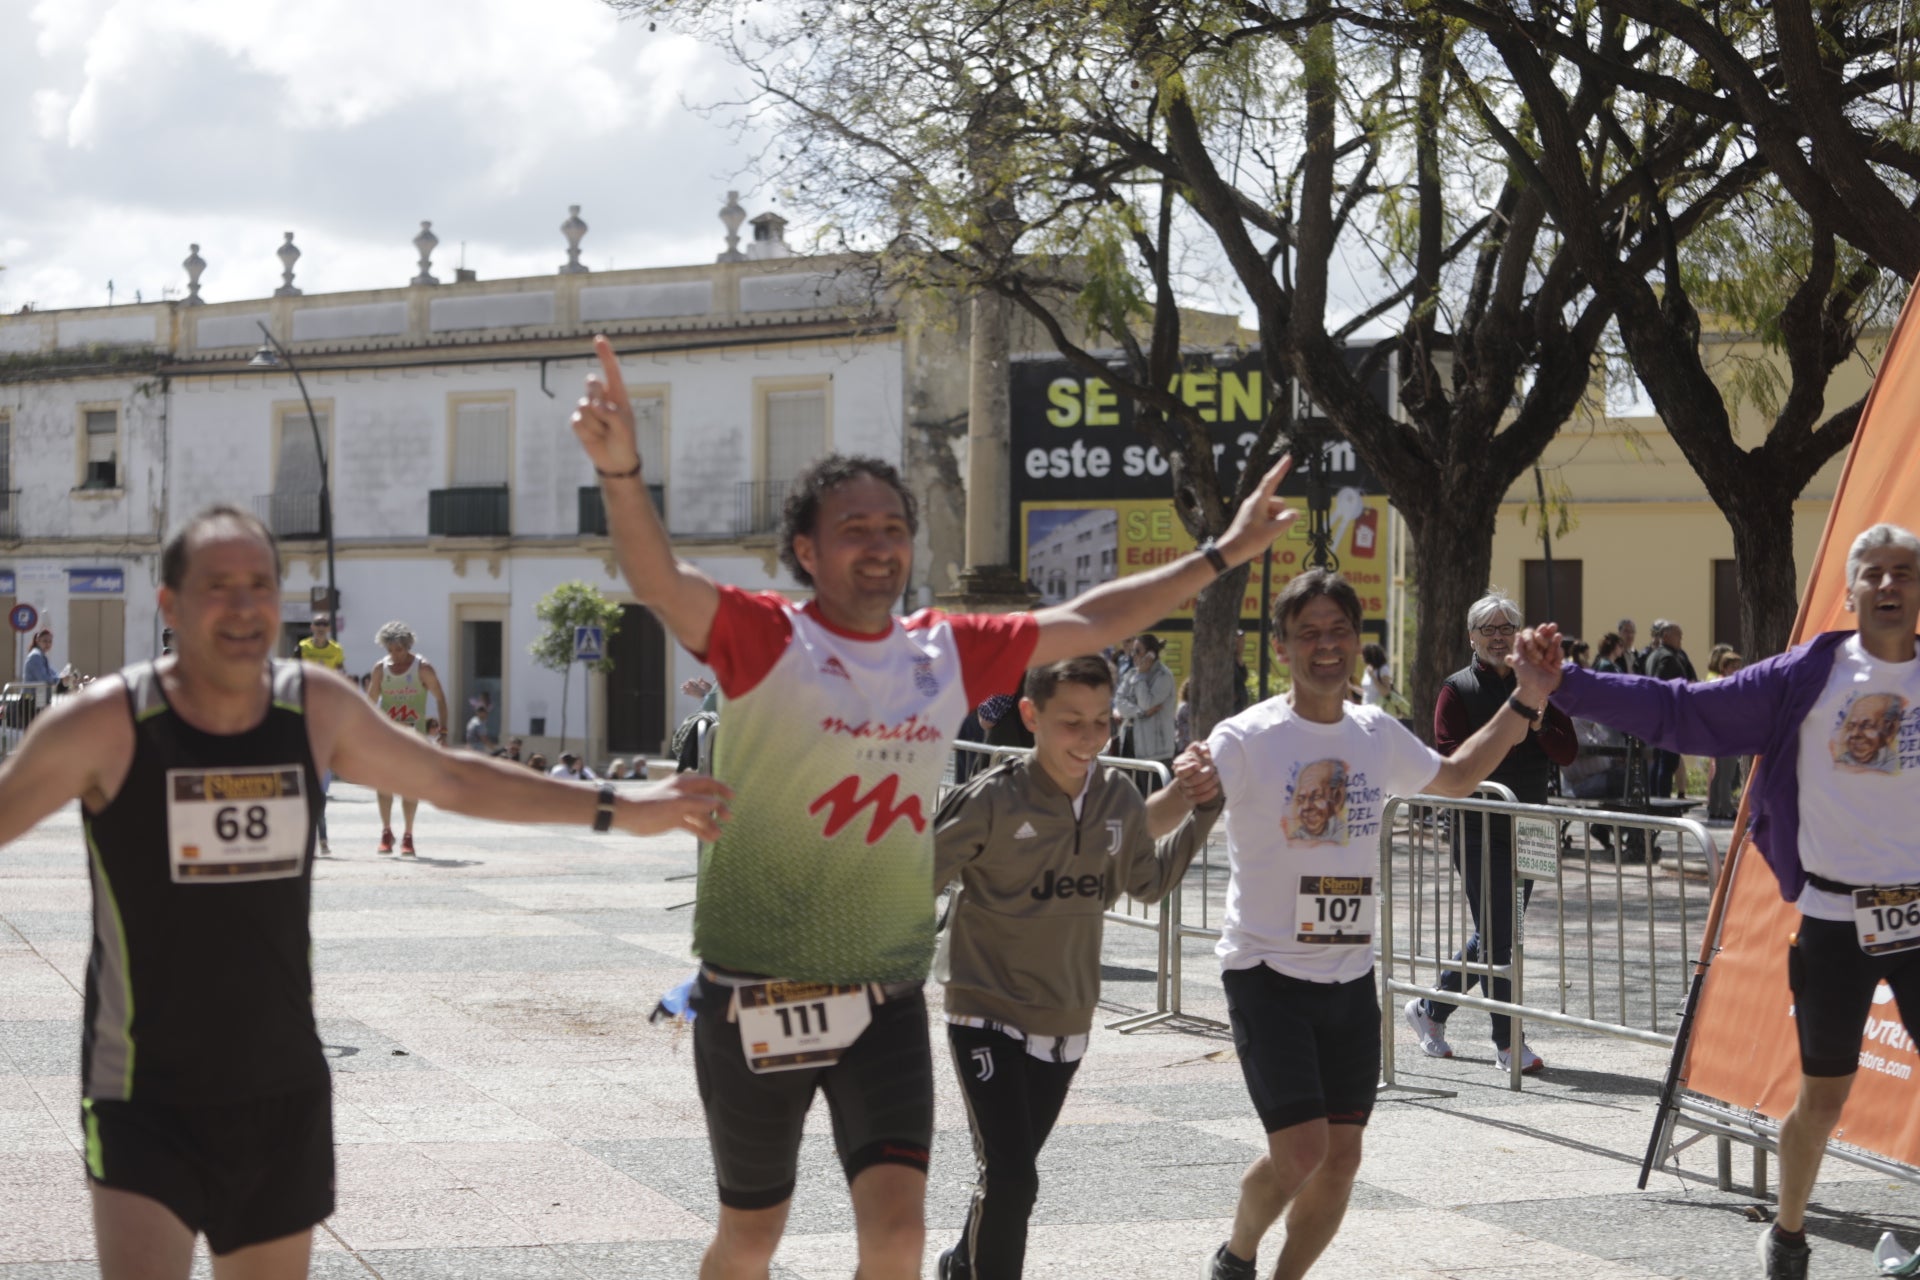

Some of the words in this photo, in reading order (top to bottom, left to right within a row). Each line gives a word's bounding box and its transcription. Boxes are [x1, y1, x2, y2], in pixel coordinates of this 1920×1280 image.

[1046, 377, 1120, 428] SE
[1025, 438, 1112, 479] este
[1126, 510, 1172, 541] SE
[1345, 773, 1367, 787] LOS
[215, 805, 269, 841] 68
[1347, 807, 1375, 822] DEL
[1348, 822, 1380, 838] PINT
[1315, 897, 1361, 922] 107
[1871, 903, 1920, 931] 106
[774, 1002, 828, 1037] 111
[1863, 1016, 1919, 1053] NUTRI
[1858, 1051, 1912, 1080] store.com
